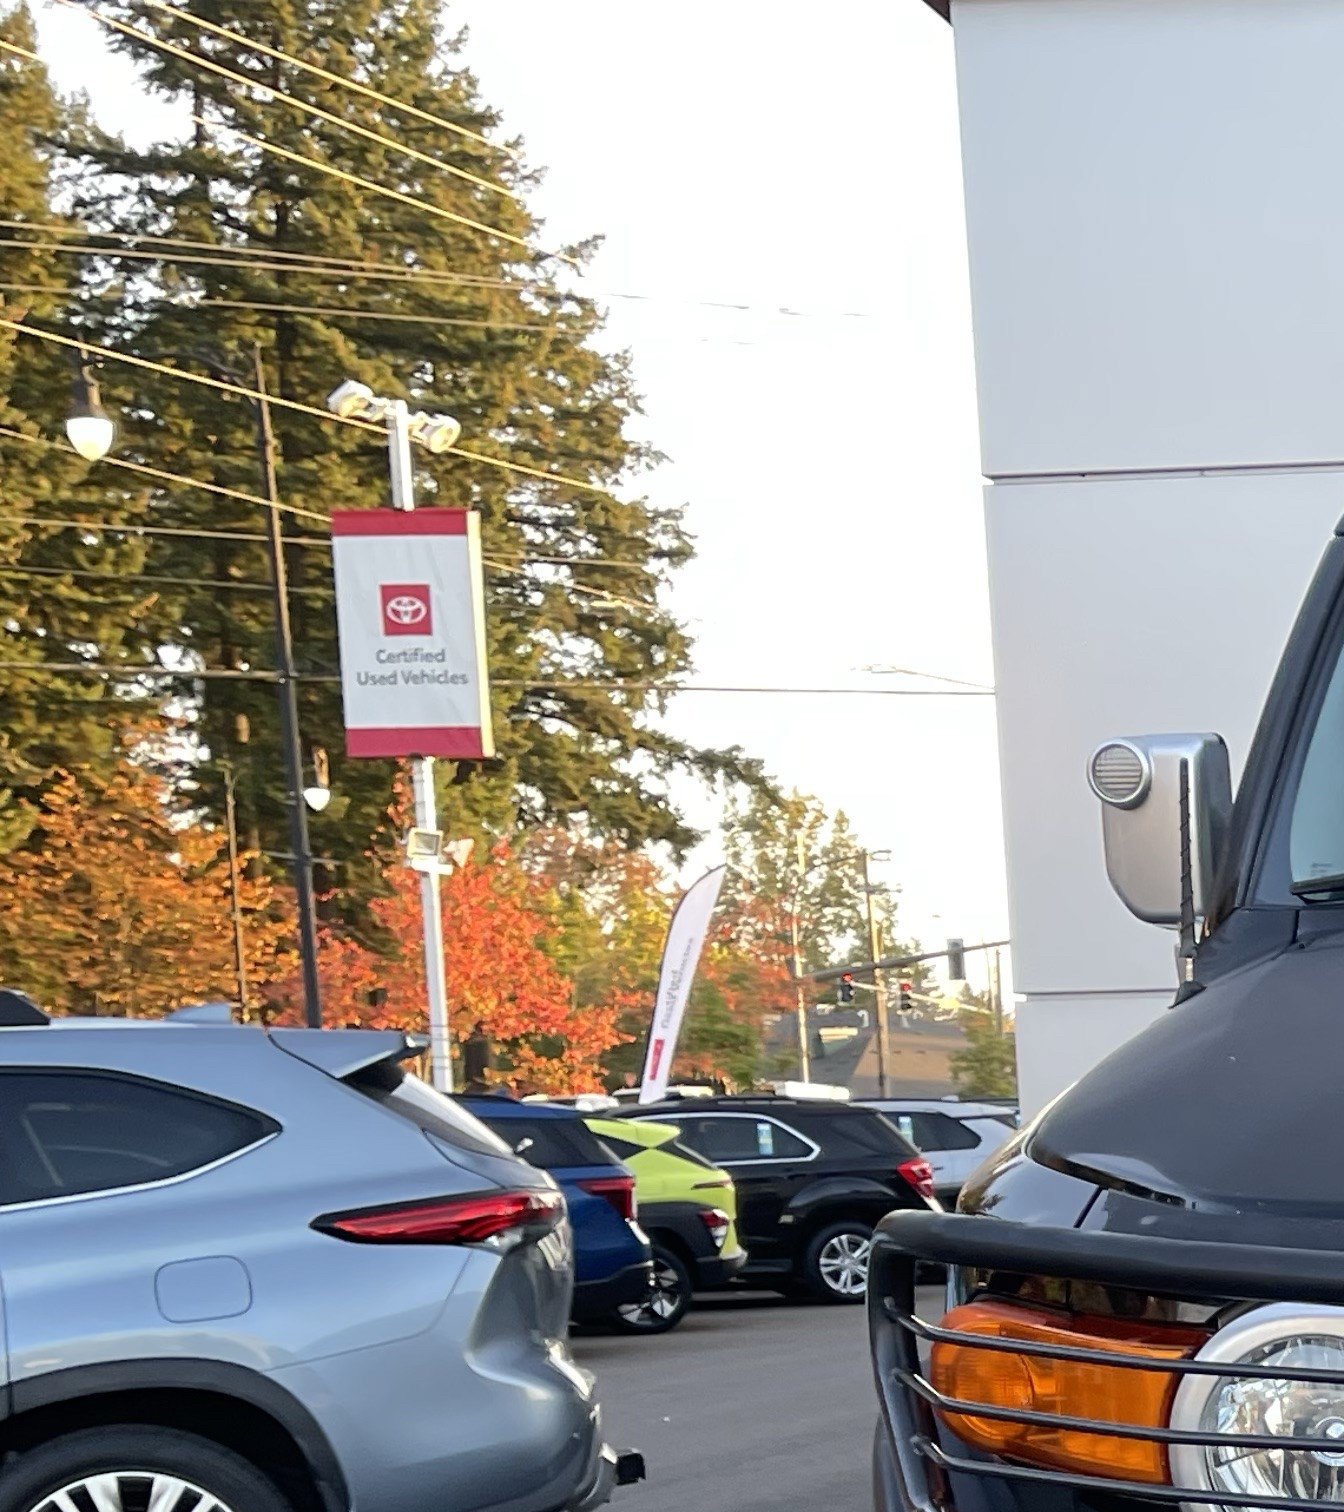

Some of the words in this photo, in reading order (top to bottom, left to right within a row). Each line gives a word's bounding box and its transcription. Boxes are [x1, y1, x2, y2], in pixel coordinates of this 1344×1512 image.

[375, 648, 447, 664] Certified
[356, 670, 398, 686] Used
[401, 669, 469, 686] Vehicles
